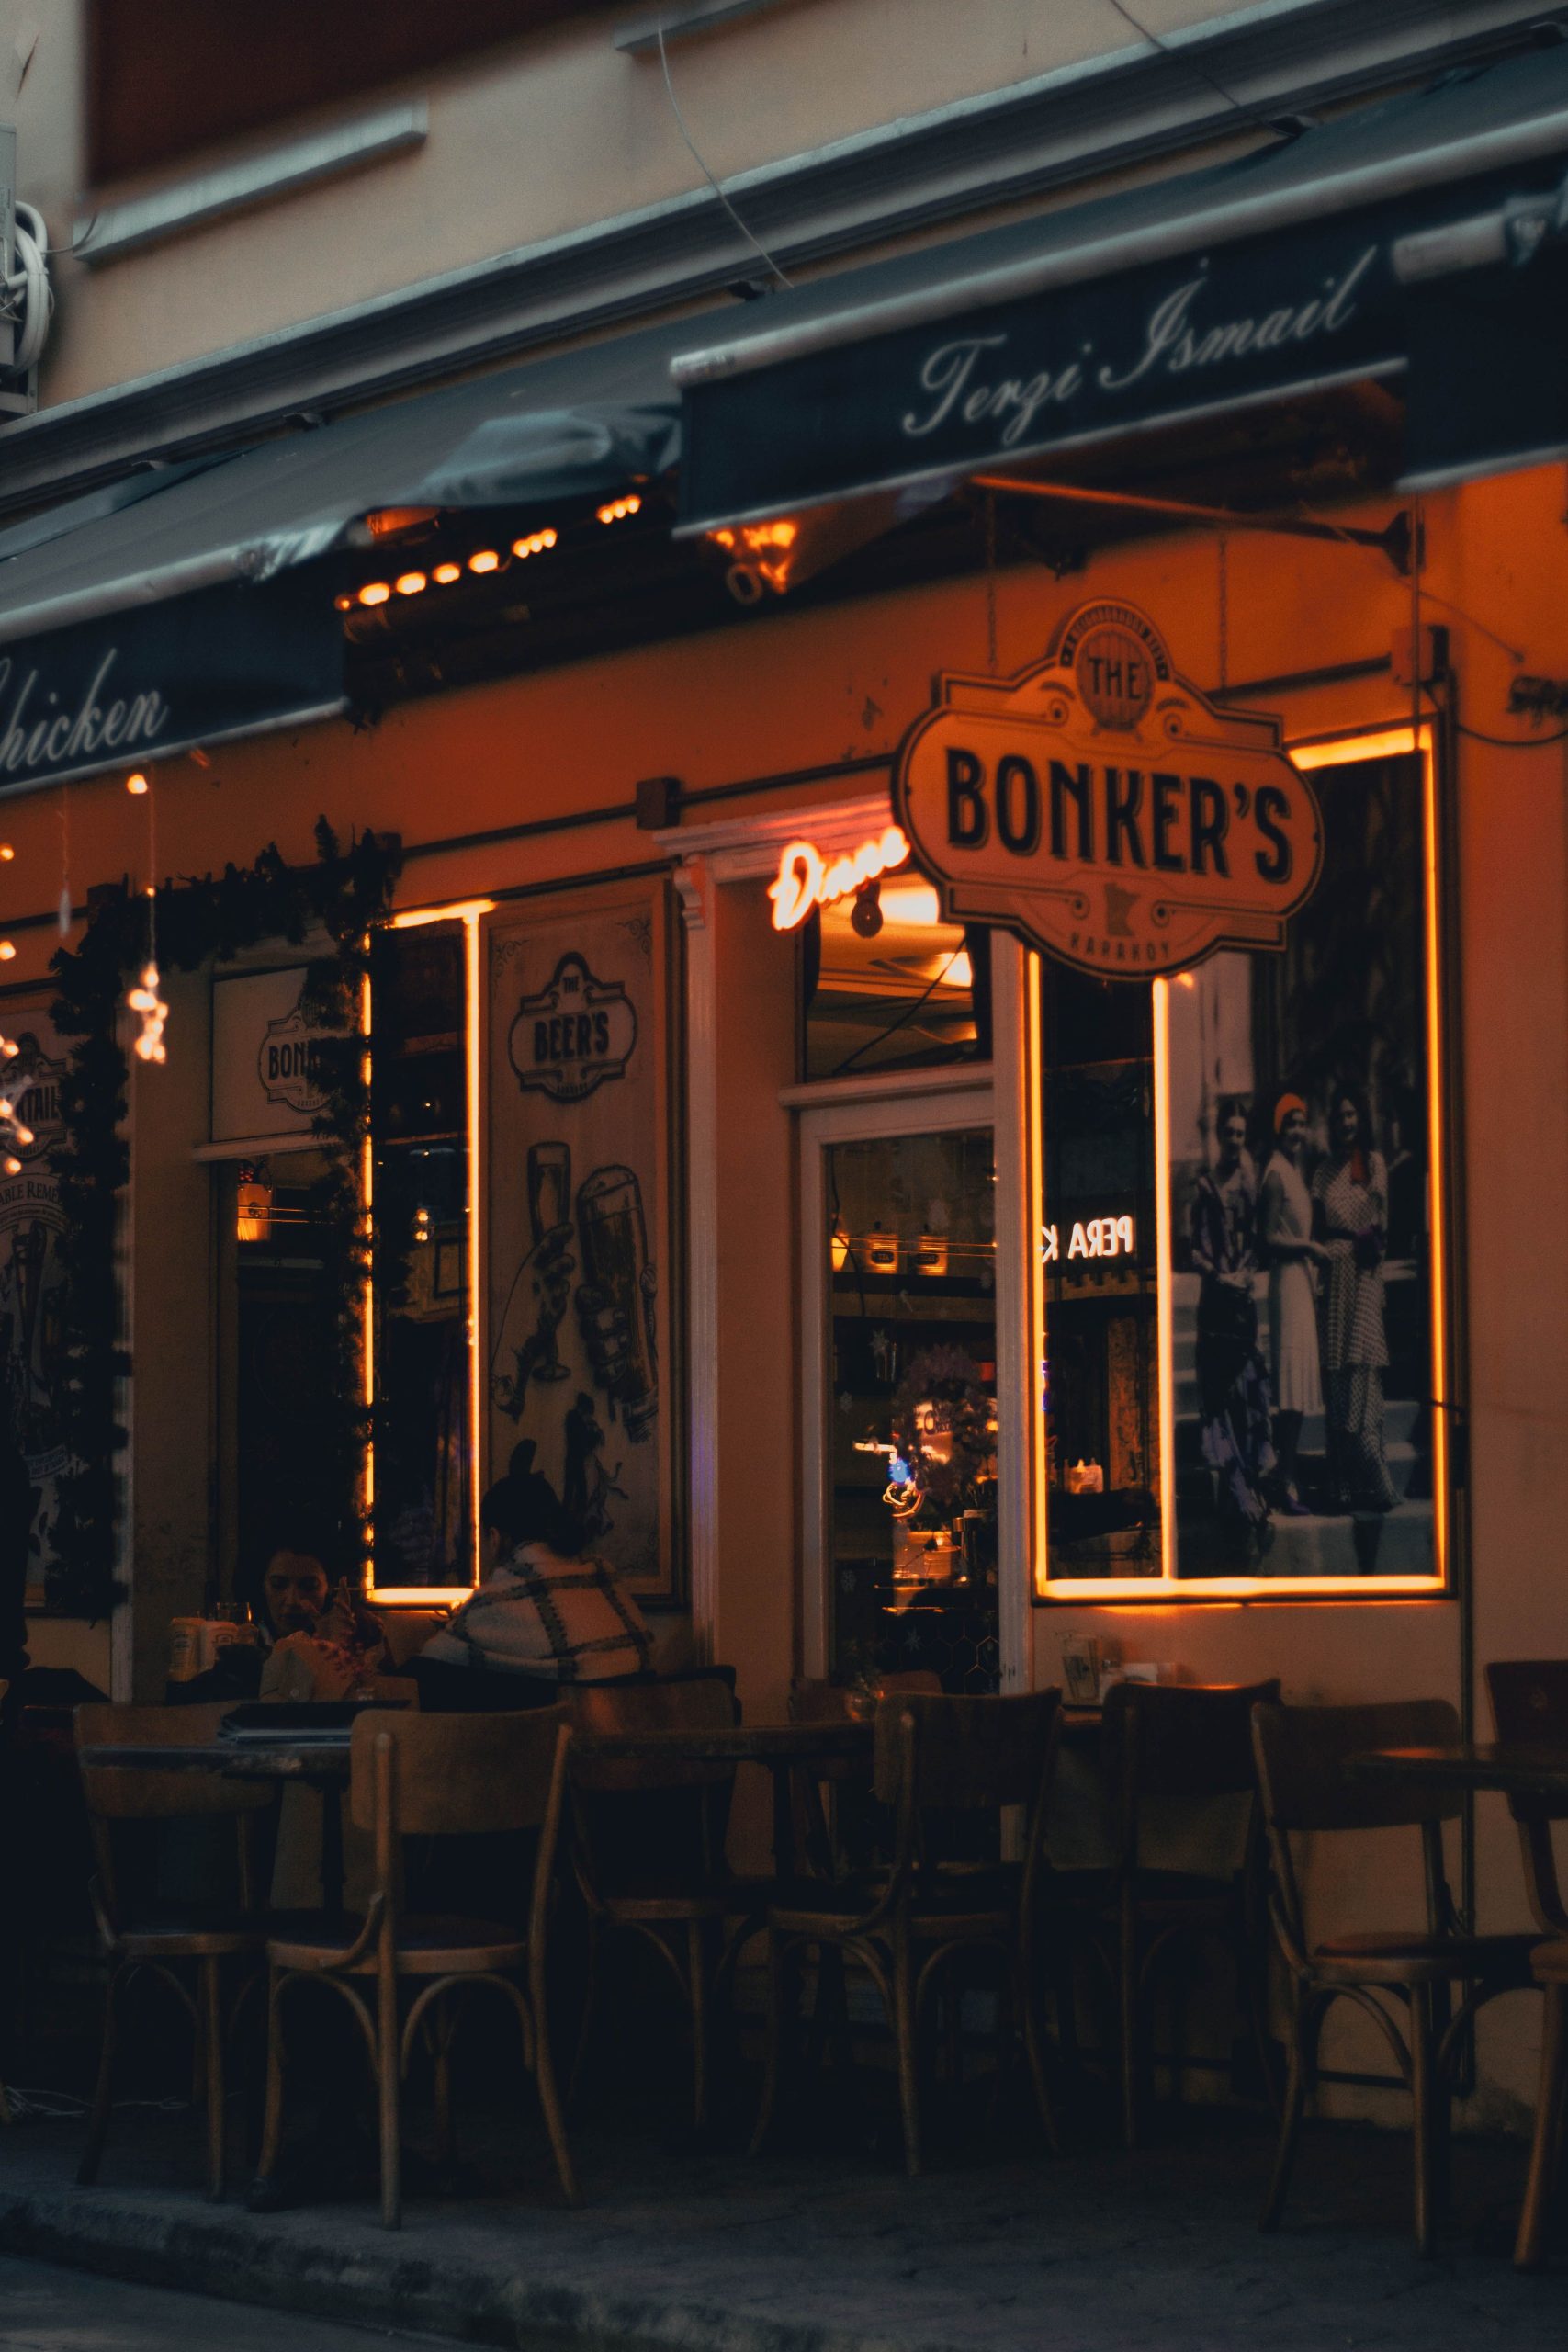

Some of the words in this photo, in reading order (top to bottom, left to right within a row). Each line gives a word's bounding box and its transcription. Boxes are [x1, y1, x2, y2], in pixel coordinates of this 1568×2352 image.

[902, 334, 1093, 447] Terzi
[0, 647, 172, 772] hicken
[1087, 656, 1144, 701] THE
[947, 748, 1293, 885] BONKER'S
